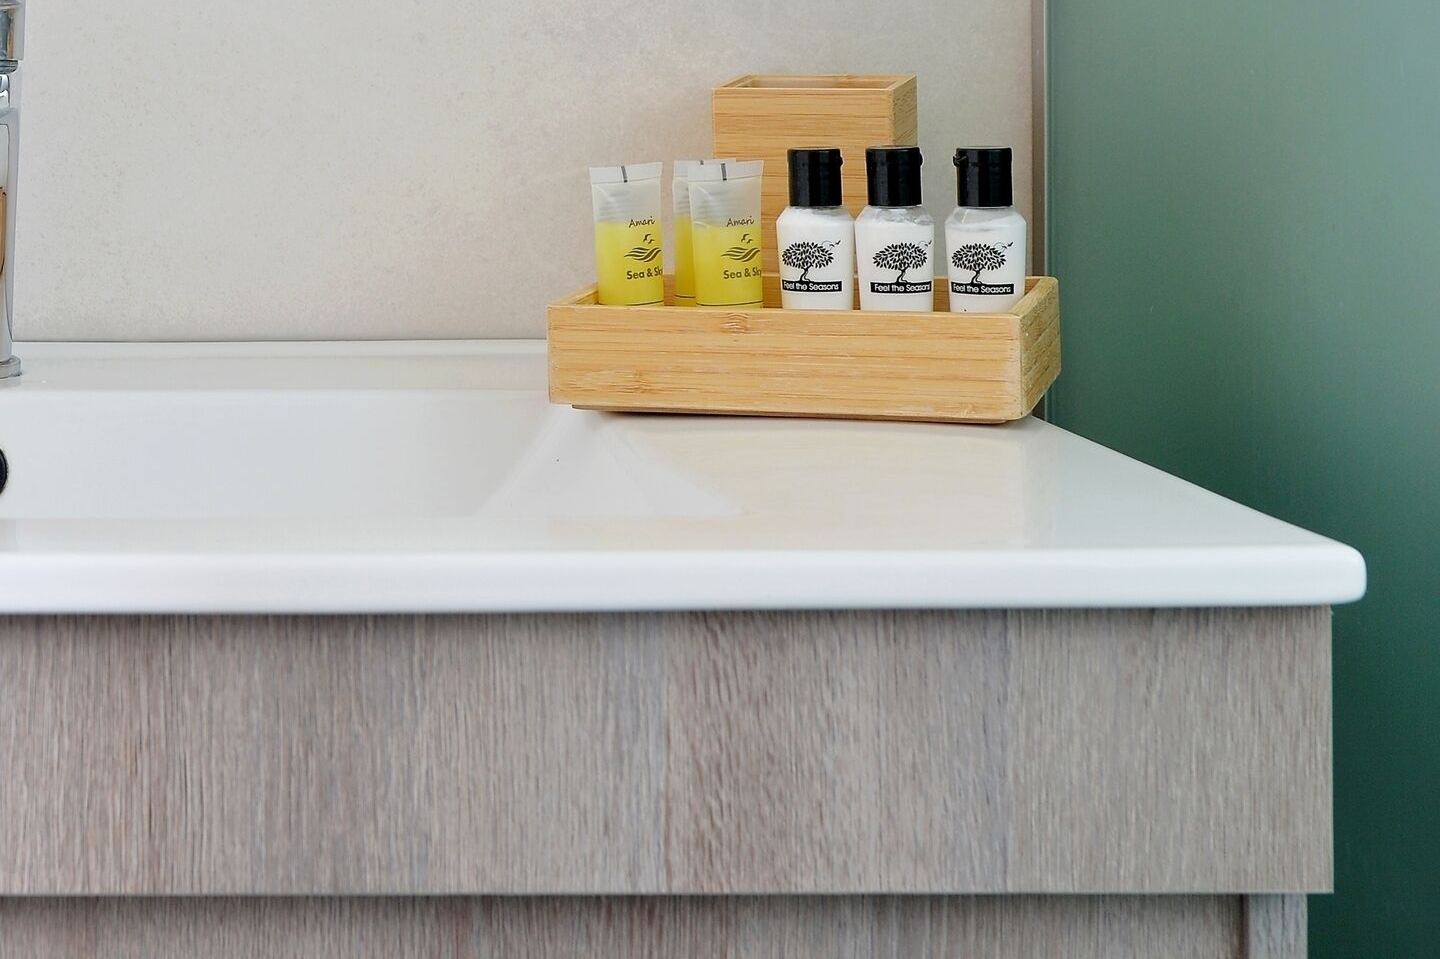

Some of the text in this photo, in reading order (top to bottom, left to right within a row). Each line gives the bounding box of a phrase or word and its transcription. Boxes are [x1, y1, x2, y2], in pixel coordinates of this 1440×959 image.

[626, 270, 645, 280] Sea
[646, 267, 653, 278] &
[723, 269, 742, 280] Sea
[744, 267, 751, 278] &
[783, 281, 839, 291] Feel the Seasons
[874, 283, 930, 293] Feel the Seasons
[953, 283, 1012, 294] Feel the Seasons
